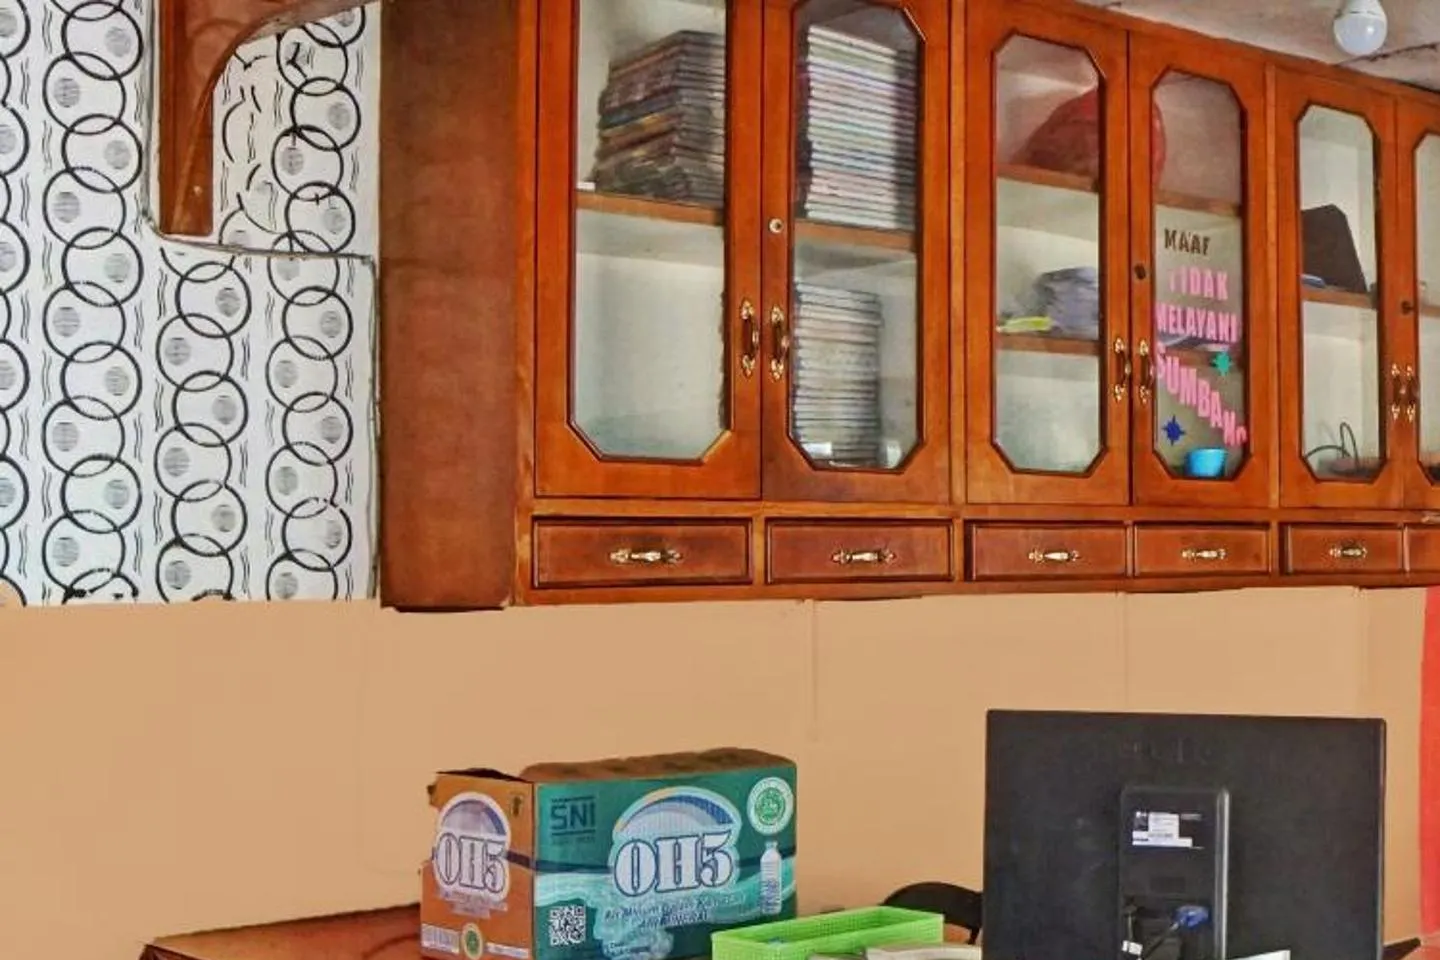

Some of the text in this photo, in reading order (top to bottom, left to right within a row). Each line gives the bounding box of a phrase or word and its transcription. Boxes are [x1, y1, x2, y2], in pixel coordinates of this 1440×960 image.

[1167, 266, 1228, 301] TIDAK
[1156, 301, 1237, 343] MELAYANI
[550, 802, 596, 830] SNI
[435, 832, 508, 894] OH5
[613, 831, 735, 897] OH5
